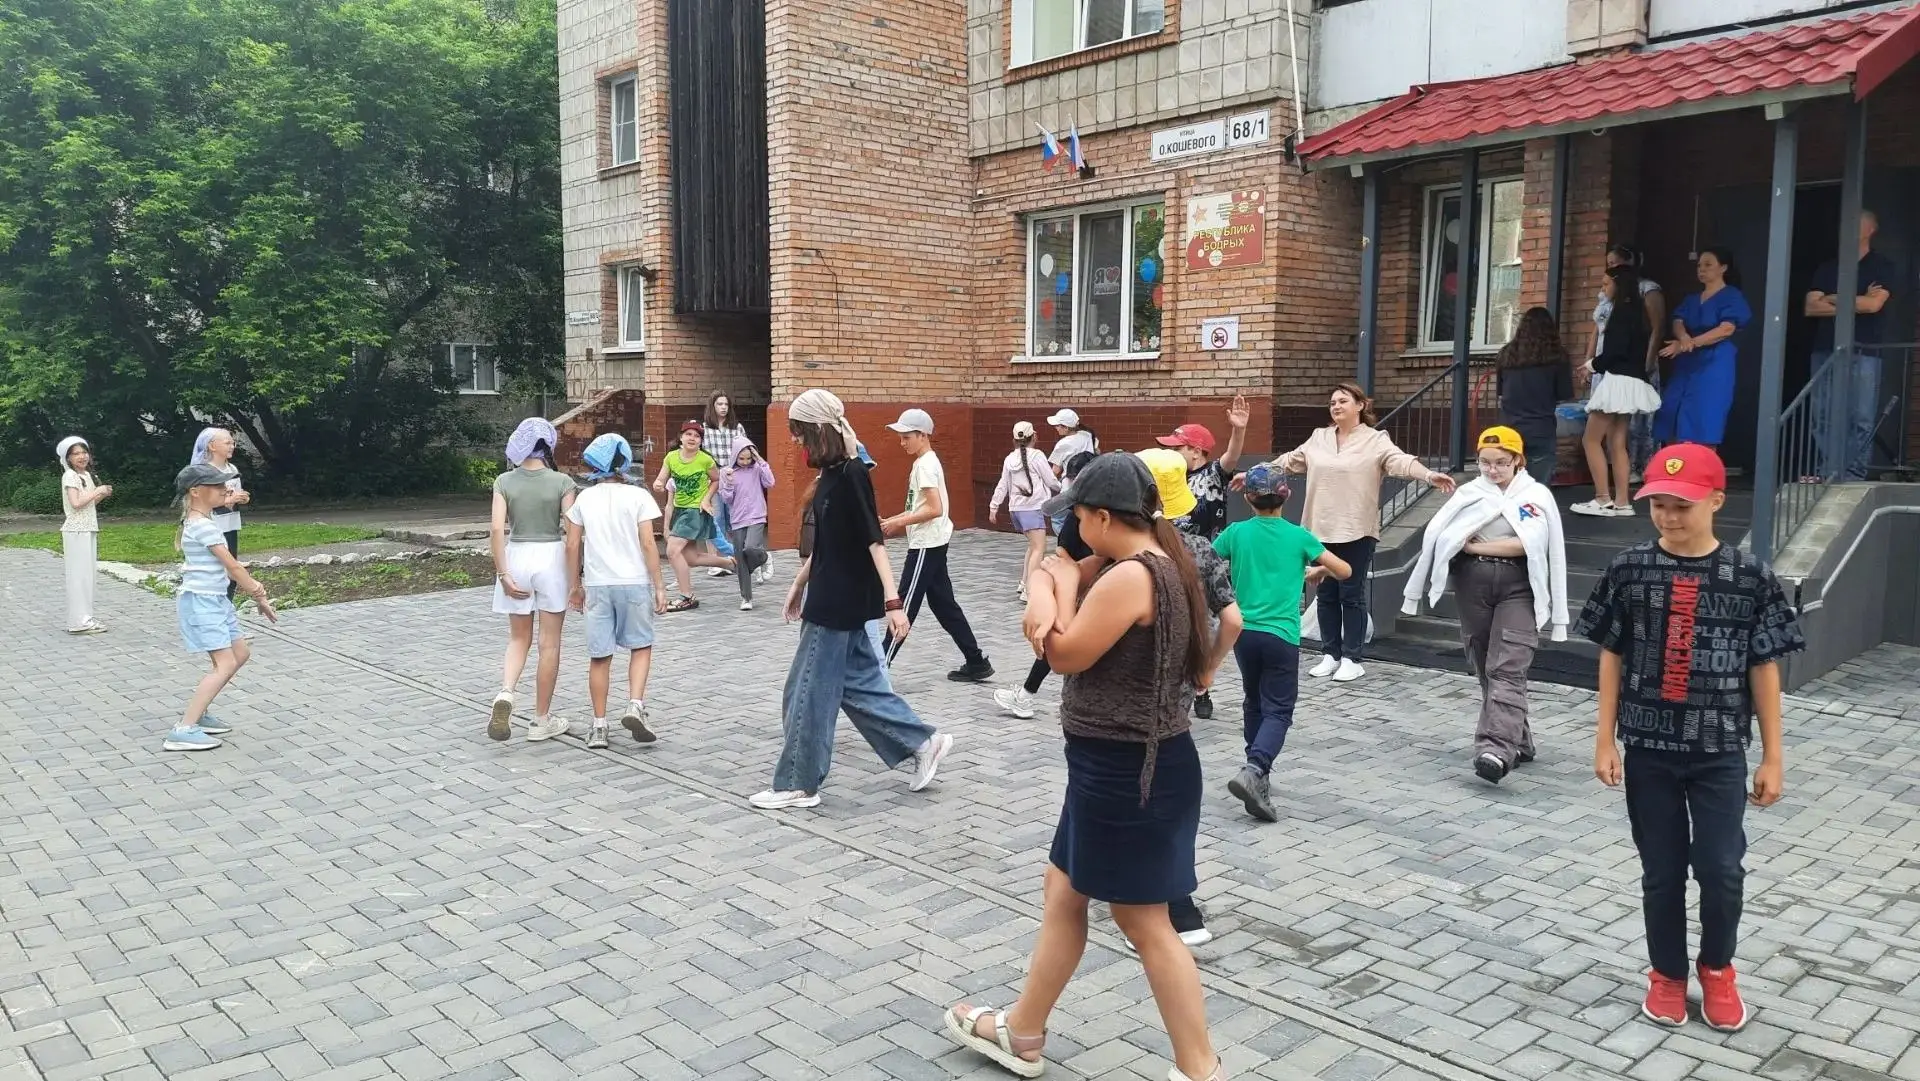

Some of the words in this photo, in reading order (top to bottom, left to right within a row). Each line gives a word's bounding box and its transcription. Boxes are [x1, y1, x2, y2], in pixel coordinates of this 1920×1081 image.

[1233, 117, 1265, 140] 68/1
[1159, 135, 1216, 155] О.КОШЕВОГО
[1193, 224, 1256, 240] РЕСПУБЛИКА
[1203, 238, 1245, 251] БОДРЫХ
[1693, 626, 1734, 639] PLAY
